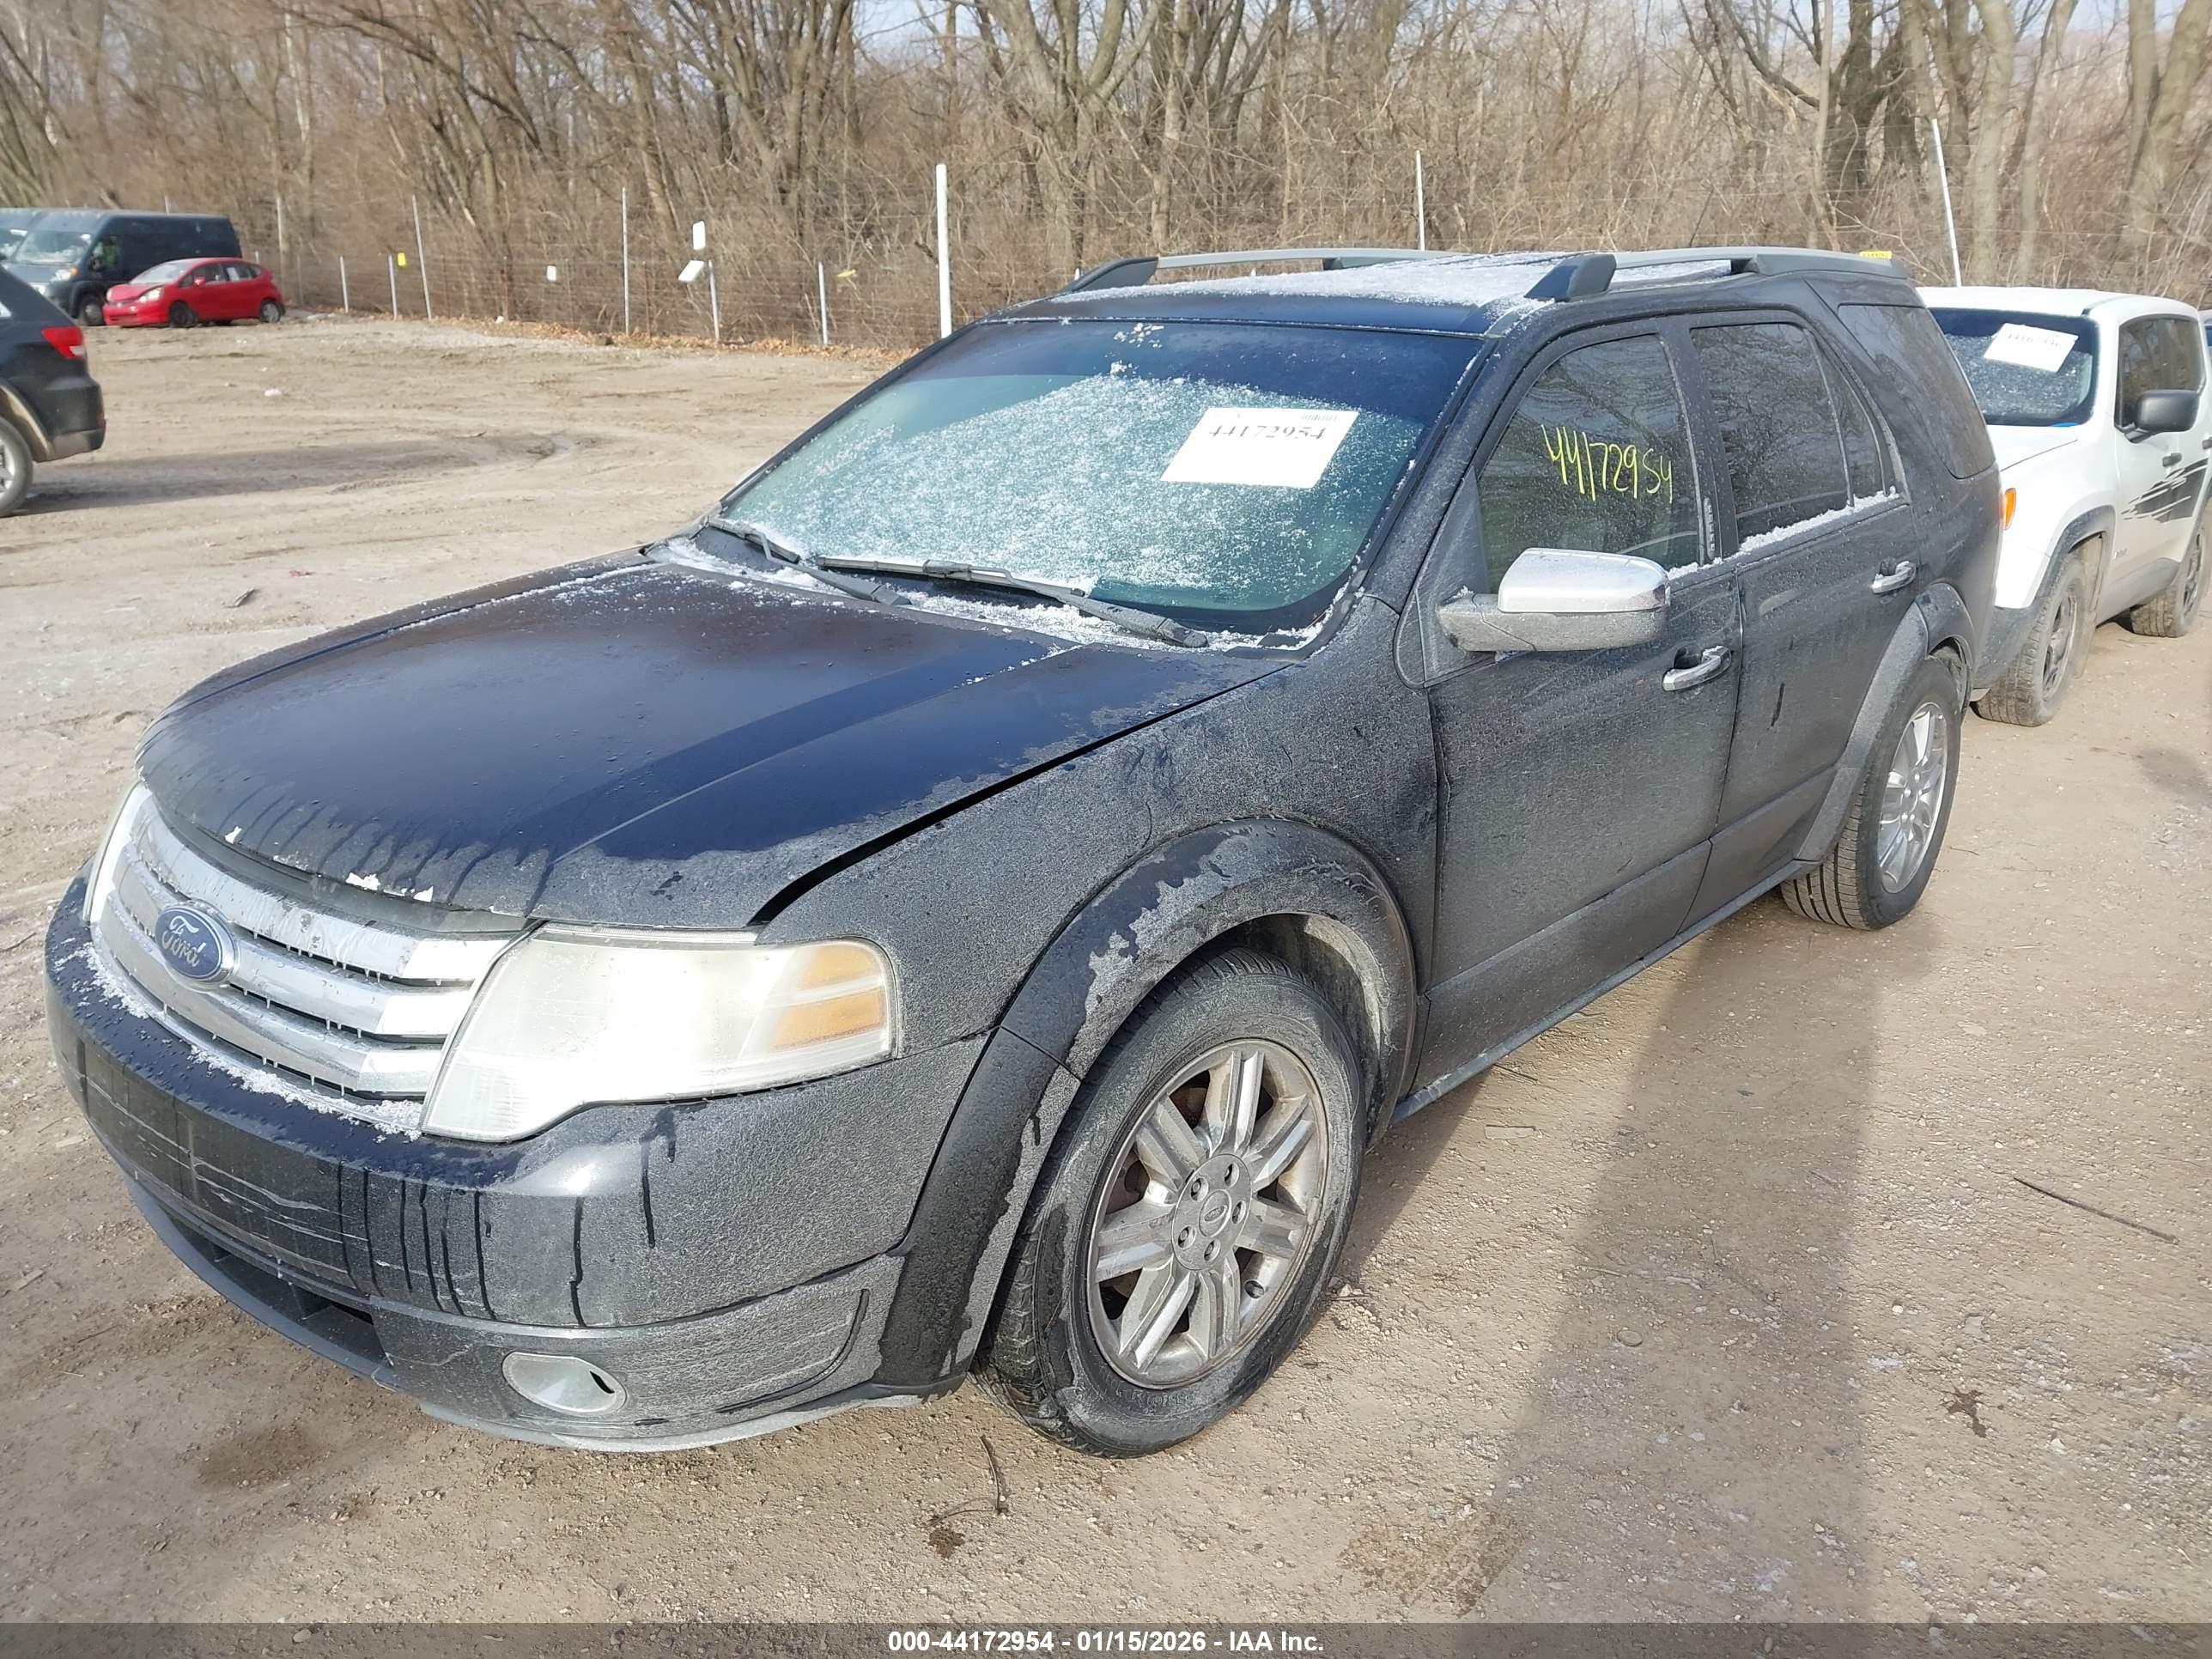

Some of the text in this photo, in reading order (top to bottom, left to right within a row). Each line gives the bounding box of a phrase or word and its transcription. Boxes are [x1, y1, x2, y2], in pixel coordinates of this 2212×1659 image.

[1208, 424, 1327, 440] 44172954
[1540, 423, 1674, 505] 44172954
[161, 915, 207, 968] Ford
